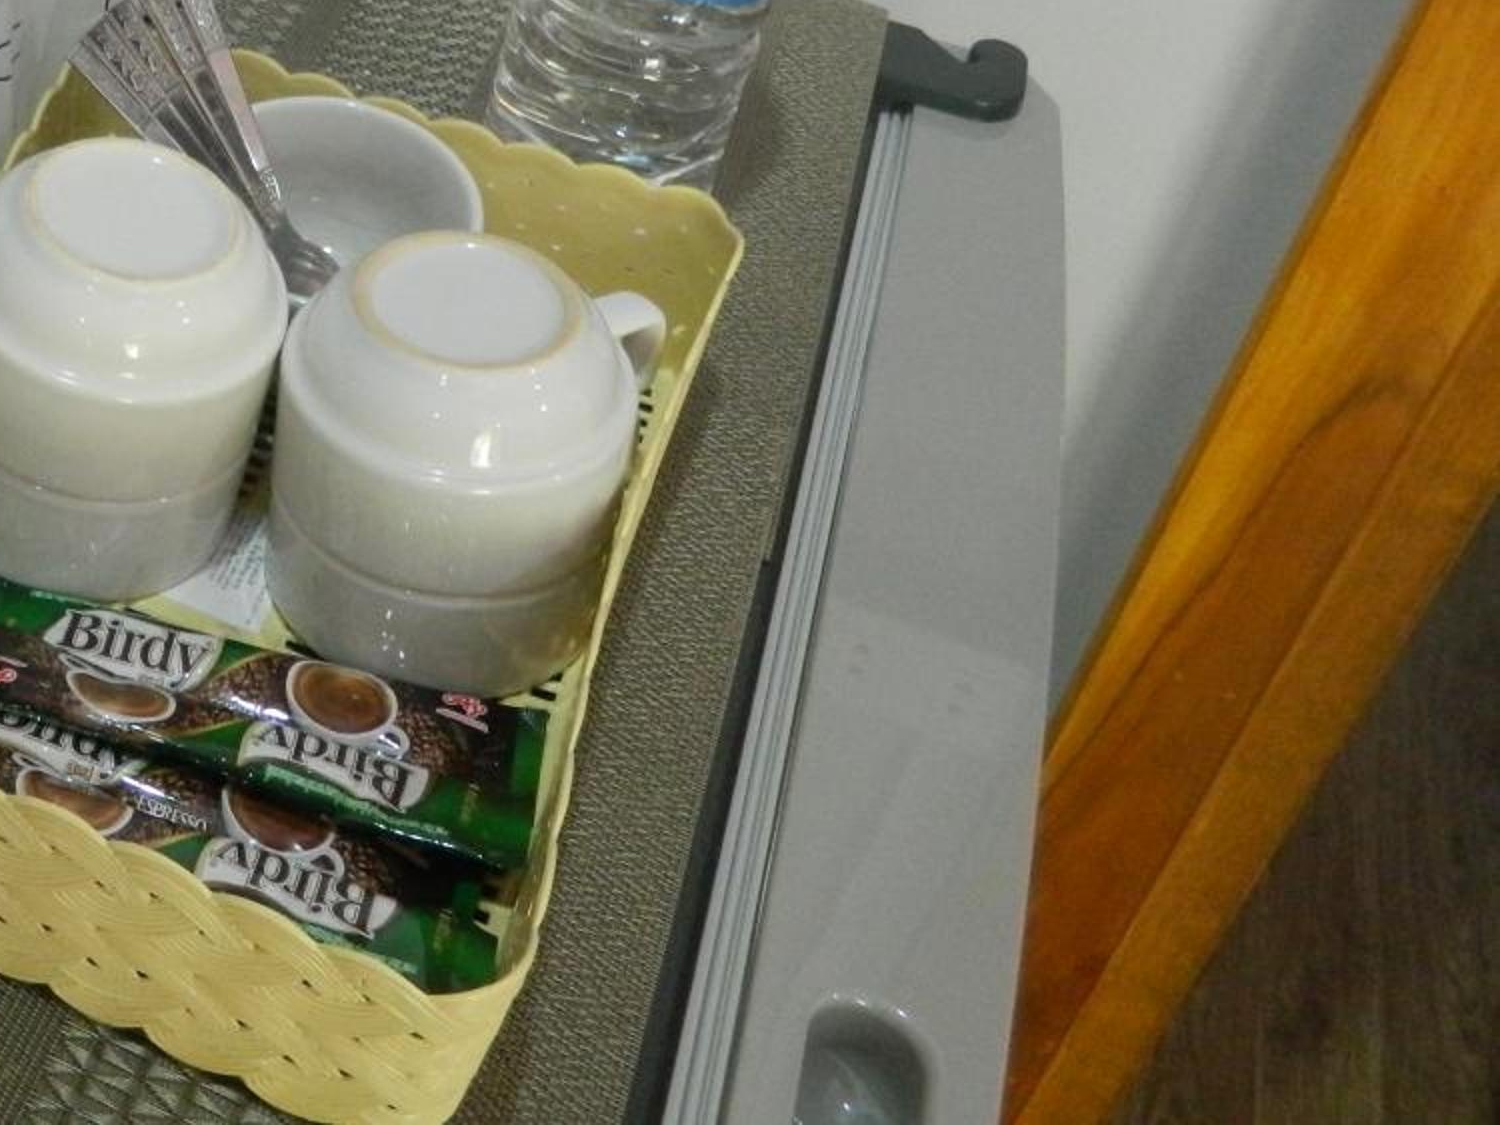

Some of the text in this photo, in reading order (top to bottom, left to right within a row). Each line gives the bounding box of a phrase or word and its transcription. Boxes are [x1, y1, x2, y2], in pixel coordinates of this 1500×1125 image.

[59, 612, 210, 689] Birdy
[259, 724, 410, 807] Birdy
[220, 840, 377, 936] Birdy
